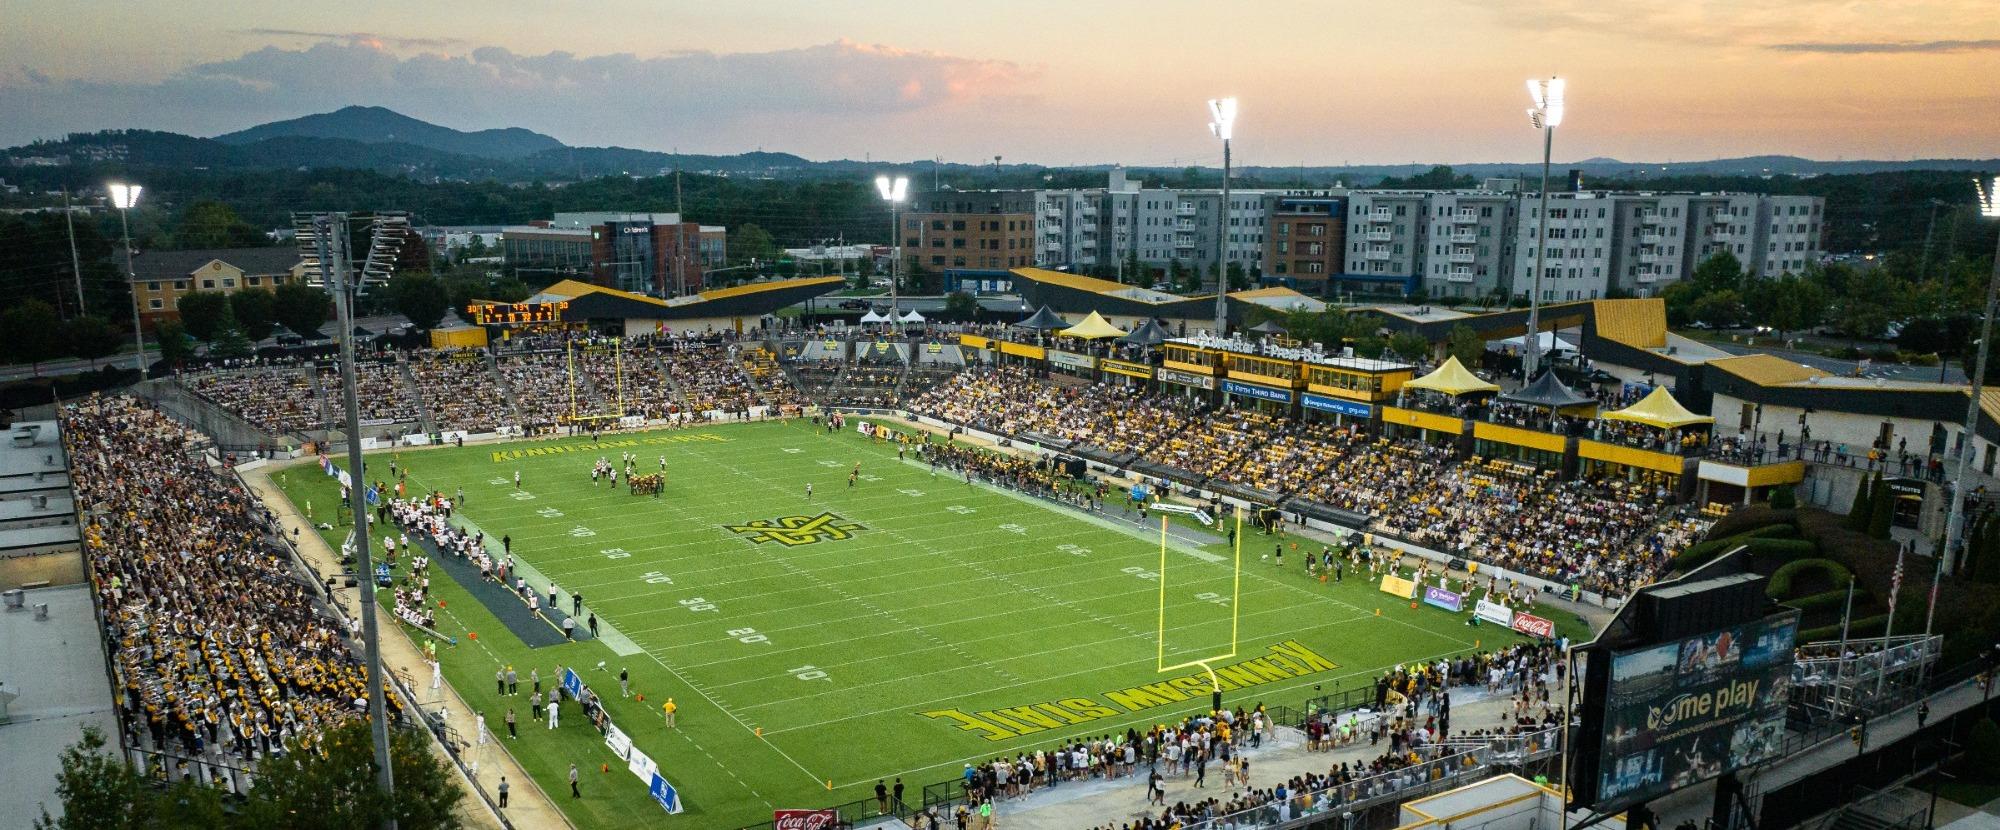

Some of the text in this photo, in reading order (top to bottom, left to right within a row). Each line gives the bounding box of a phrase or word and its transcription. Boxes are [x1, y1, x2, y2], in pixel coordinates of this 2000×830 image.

[1235, 386, 1287, 401] FIFTH THIRD BANK
[640, 570, 672, 585] 40
[679, 597, 717, 613] 30
[727, 627, 769, 645] 20
[788, 665, 829, 682] 10
[915, 638, 1343, 742] KENNESAW STATE
[1704, 679, 1760, 718] play
